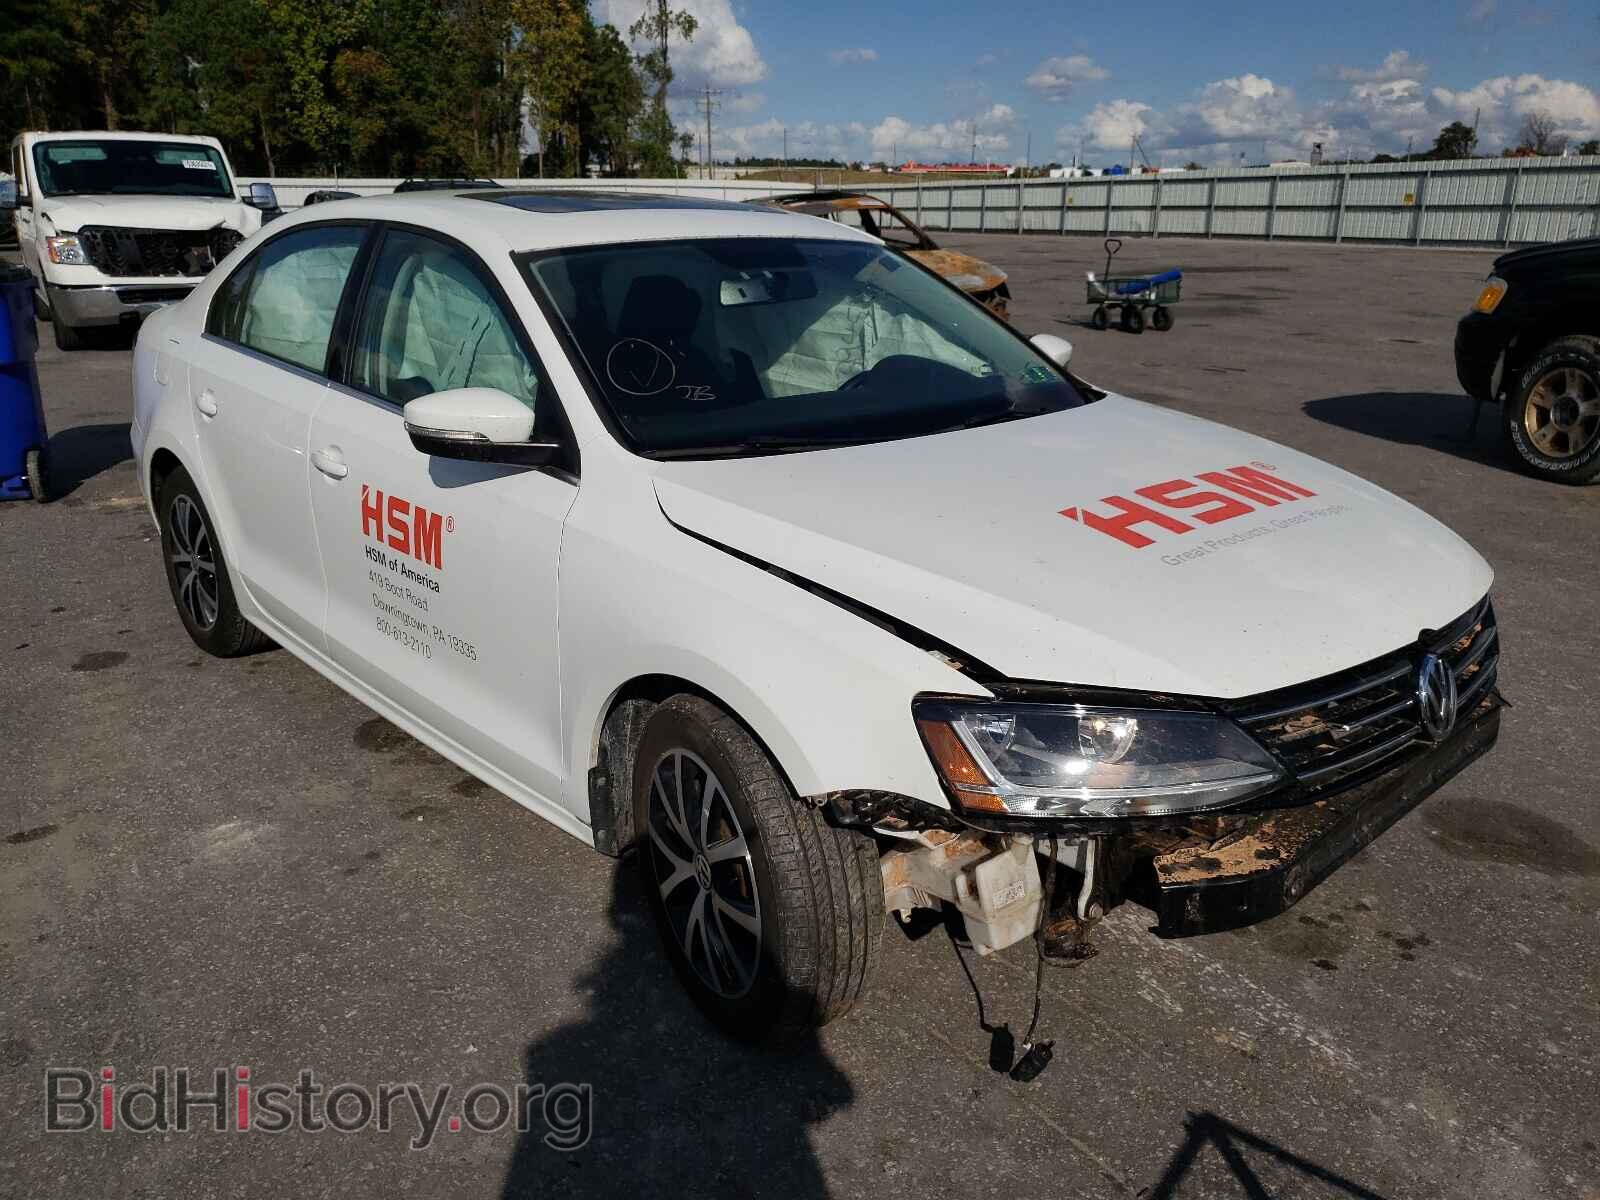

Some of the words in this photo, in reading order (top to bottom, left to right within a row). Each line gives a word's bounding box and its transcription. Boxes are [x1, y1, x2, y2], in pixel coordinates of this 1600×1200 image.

[1160, 545, 1213, 567] Great
[1269, 512, 1309, 529] Great
[364, 544, 387, 568] HSM
[388, 559, 398, 573] of
[400, 562, 440, 593] America
[368, 570, 384, 588] 419
[405, 587, 428, 612] Road
[376, 616, 431, 659] 800-613-2110
[432, 625, 448, 646] PA
[448, 634, 477, 661] 19335
